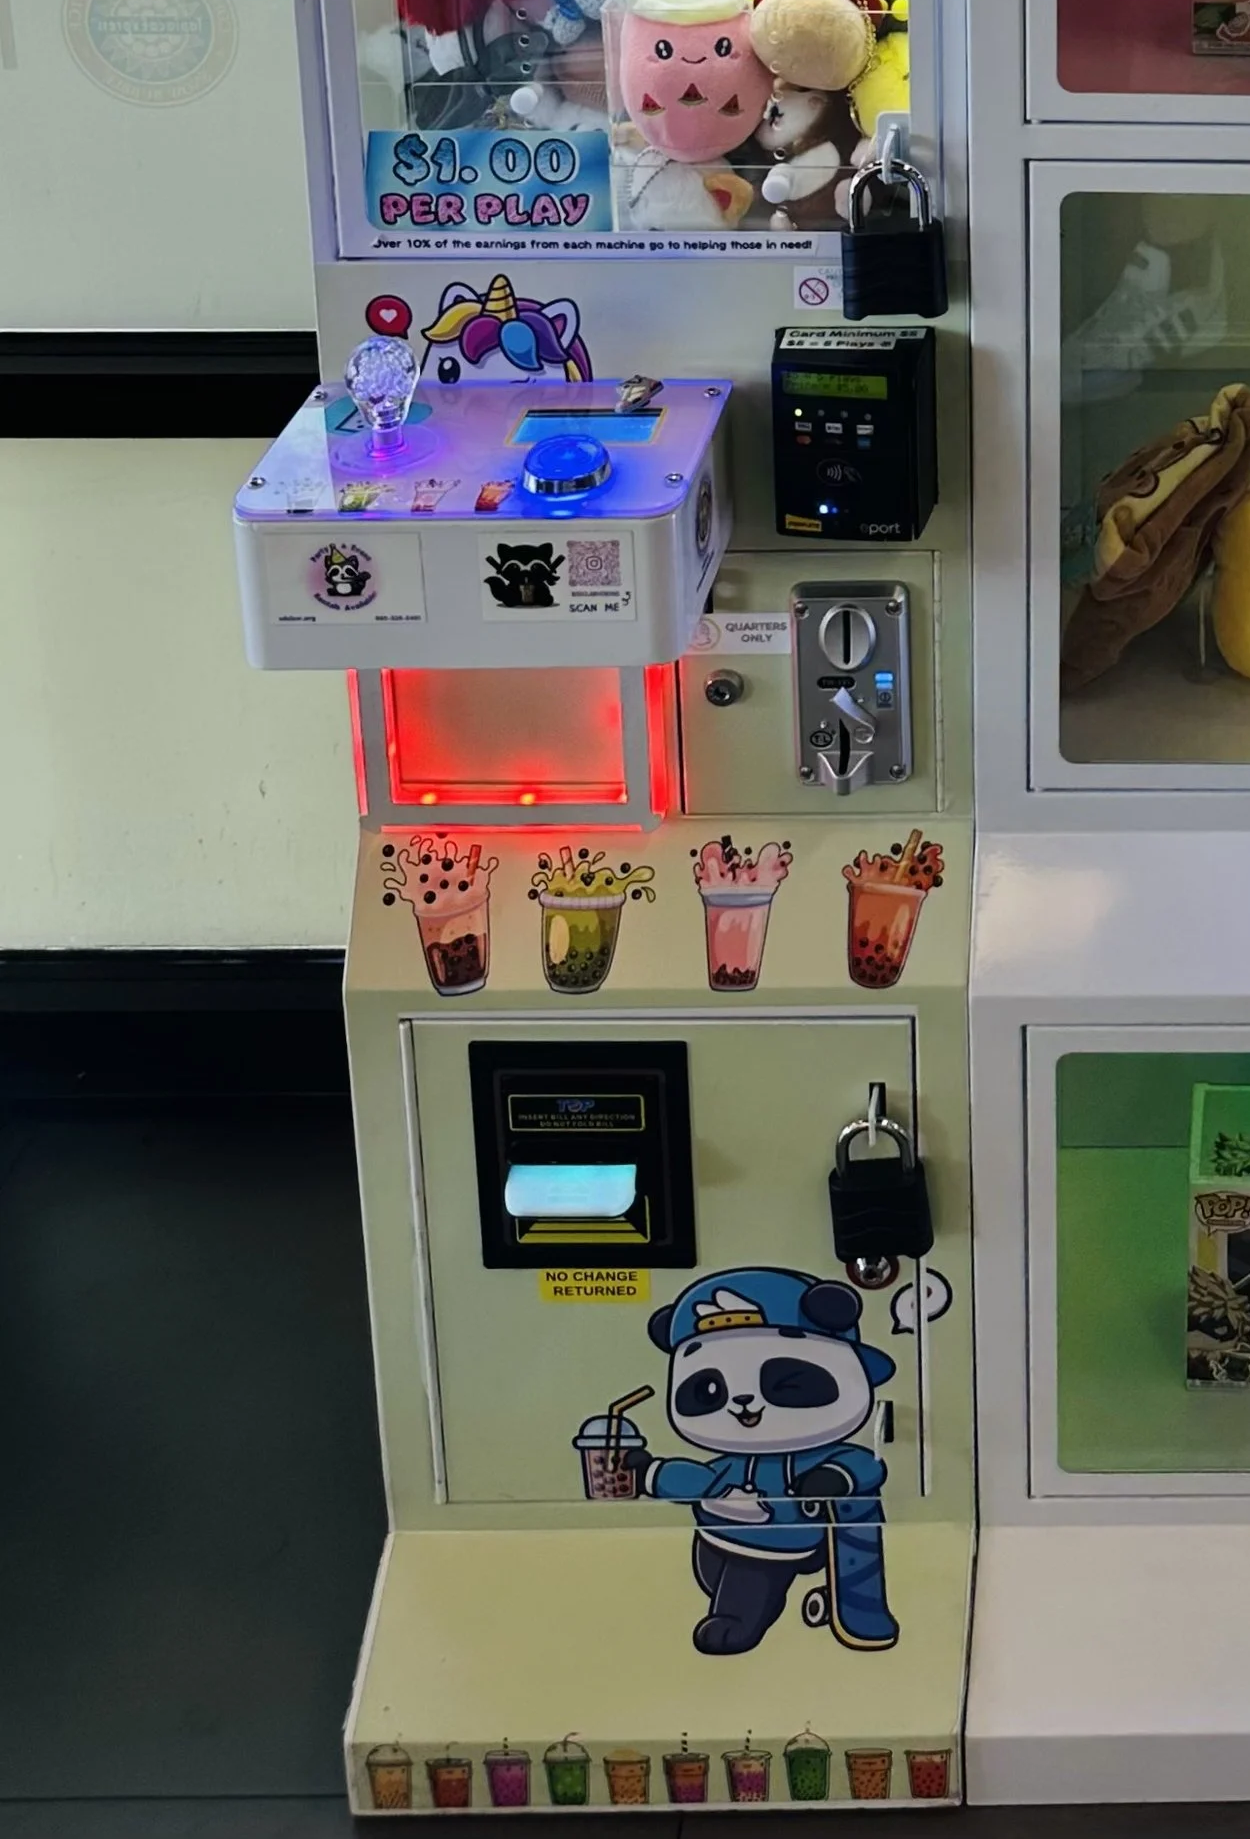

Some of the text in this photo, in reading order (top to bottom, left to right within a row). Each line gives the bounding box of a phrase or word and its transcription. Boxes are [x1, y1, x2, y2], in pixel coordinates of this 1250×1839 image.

[392, 132, 578, 186] $1.00
[379, 193, 592, 226] PER PLAY
[789, 330, 826, 338] Card
[828, 330, 896, 338] Minimum
[835, 339, 875, 348] Plays
[569, 603, 620, 612] SCAN ME
[725, 622, 788, 633] QUARTERS
[740, 633, 773, 643] ONLY
[555, 1098, 596, 1113] TOP
[546, 1271, 638, 1282] NO CHANGE
[553, 1286, 637, 1296] RETURNED
